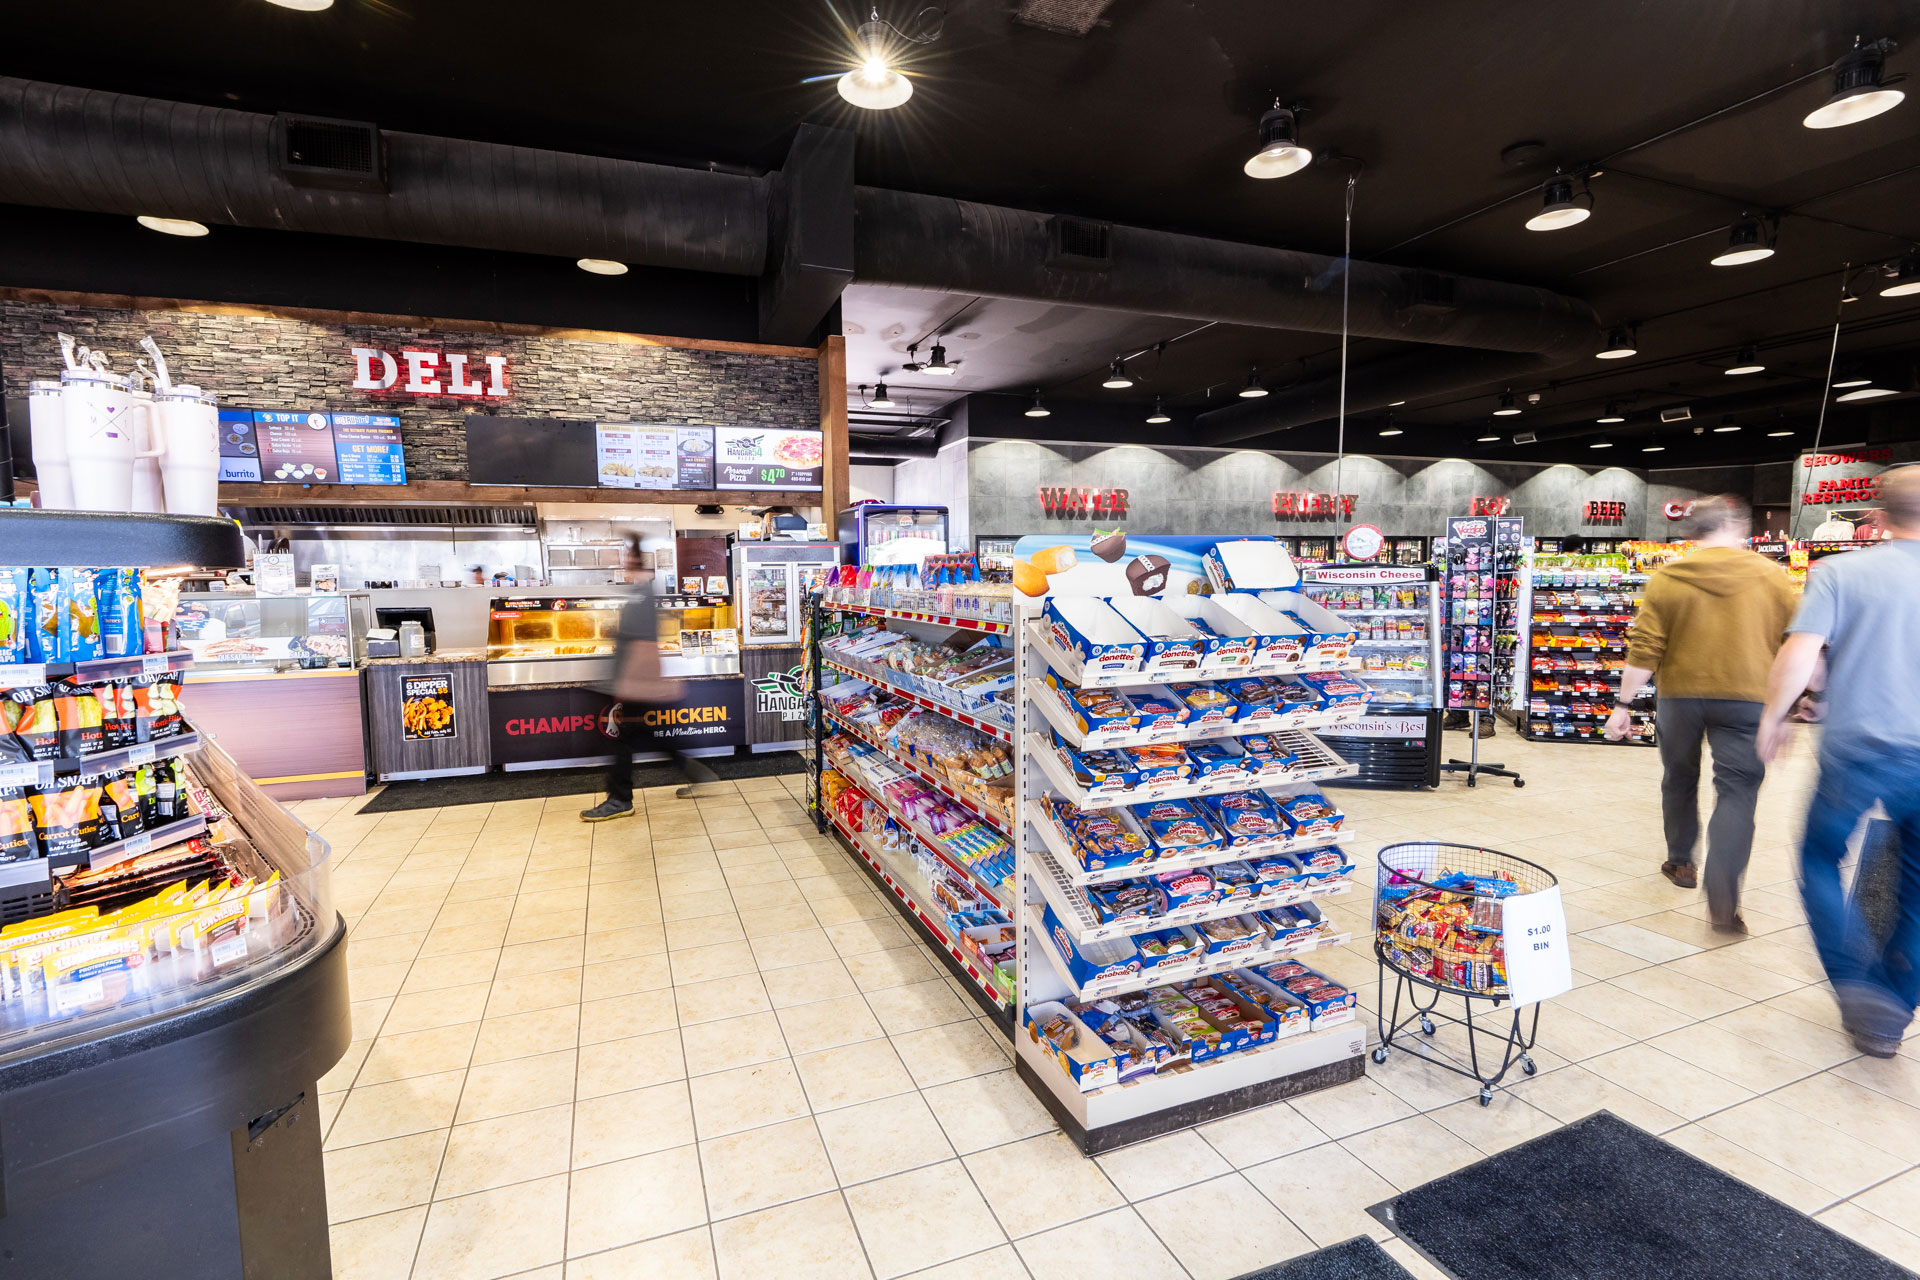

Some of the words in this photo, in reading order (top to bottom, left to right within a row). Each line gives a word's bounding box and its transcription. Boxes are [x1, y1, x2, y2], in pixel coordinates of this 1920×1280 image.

[352, 346, 509, 398] DELI
[276, 414, 290, 422] TOP
[291, 414, 299, 422] IT
[352, 445, 364, 453] GET
[366, 446, 389, 454] MORE!
[727, 446, 762, 457] HANGAR54
[1803, 448, 1892, 468] SHOWERS
[226, 470, 255, 478] burrito
[724, 466, 754, 476] Personal
[1817, 475, 1884, 492] FAMILY
[1040, 487, 1131, 510] WATER
[1274, 492, 1360, 513] ENERGY
[1590, 500, 1627, 517] BEER
[1318, 570, 1376, 579] Wisconsin
[1380, 570, 1422, 578] Cheese
[1050, 624, 1074, 652] donettes
[1267, 643, 1298, 652] donettes
[1317, 641, 1347, 650] donettes
[1161, 650, 1196, 659] donettes
[1216, 646, 1248, 656] donettes
[1099, 653, 1135, 662] donettes
[414, 680, 448, 689] DIPPER
[12, 688, 34, 704] OH
[643, 706, 728, 726] CHICKEN
[1201, 714, 1224, 722] Zingers
[505, 714, 595, 736] CHAMPS
[1328, 721, 1392, 732] Wisconsin's
[1397, 720, 1424, 734] Best
[672, 727, 702, 737] Mealtime
[703, 726, 727, 734] HERO.
[58, 773, 99, 788] SNAP!
[1148, 776, 1180, 784] Cupcakes
[38, 830, 70, 840] Carrot
[71, 826, 96, 836] Cuties
[1312, 856, 1328, 864] Honey
[1172, 874, 1209, 890] Snoballs
[1178, 900, 1211, 909] Snoballs
[199, 902, 245, 930] LUNCHABLES
[1286, 930, 1314, 940] Danish
[1527, 924, 1552, 936] $1.00
[1222, 944, 1252, 954] Danish
[1533, 941, 1550, 951] BIN
[79, 960, 104, 974] PROTEIN
[106, 958, 123, 968] PACK
[1158, 956, 1189, 968] Danish
[1096, 970, 1130, 980] Snoballs
[1322, 1007, 1348, 1016] Cupcakes
